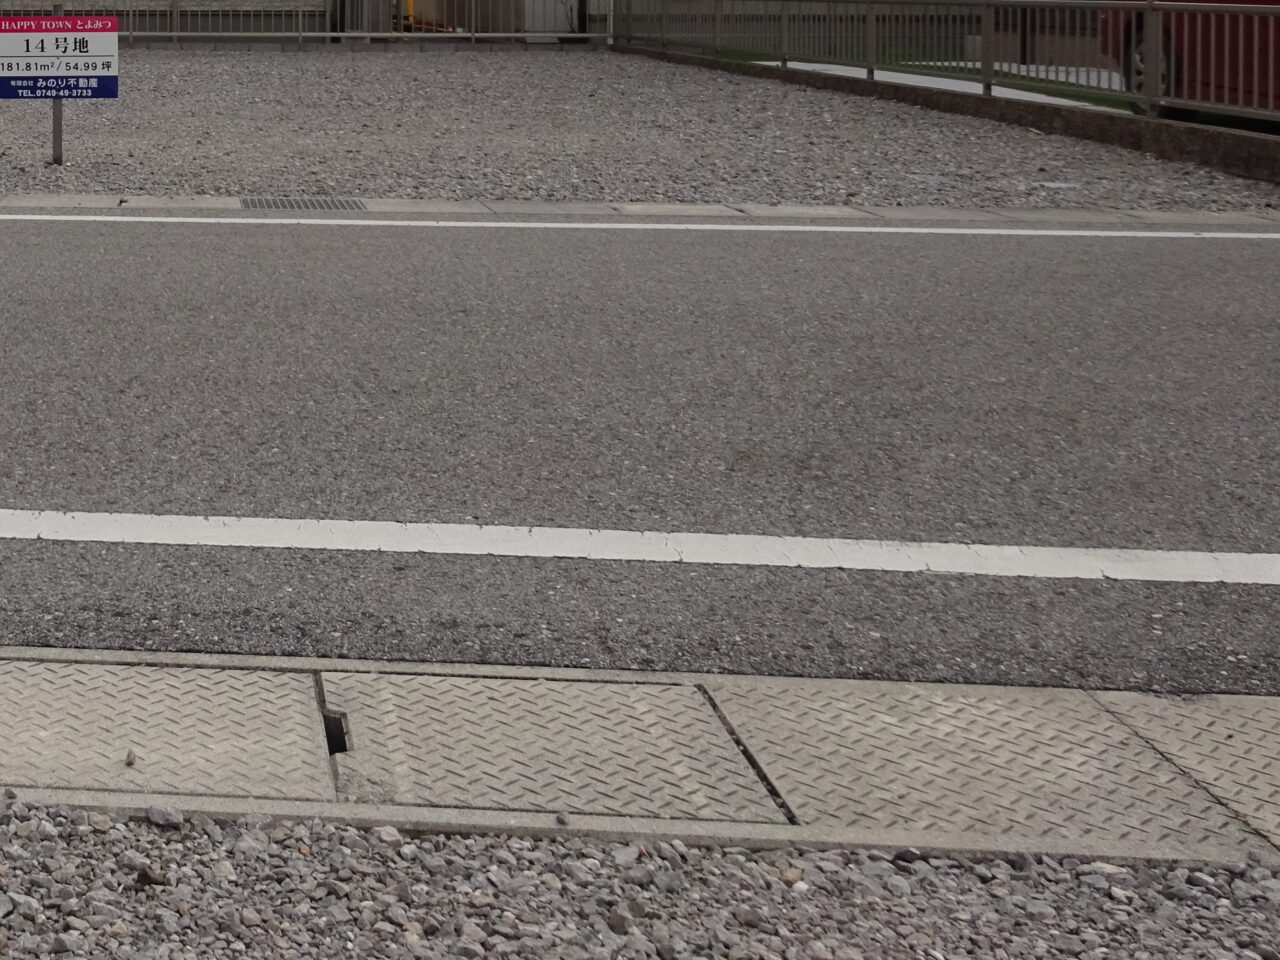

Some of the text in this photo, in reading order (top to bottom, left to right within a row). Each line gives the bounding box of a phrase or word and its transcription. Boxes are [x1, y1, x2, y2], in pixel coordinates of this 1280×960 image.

[1, 20, 112, 30] HAPPY TOWN とよみつ
